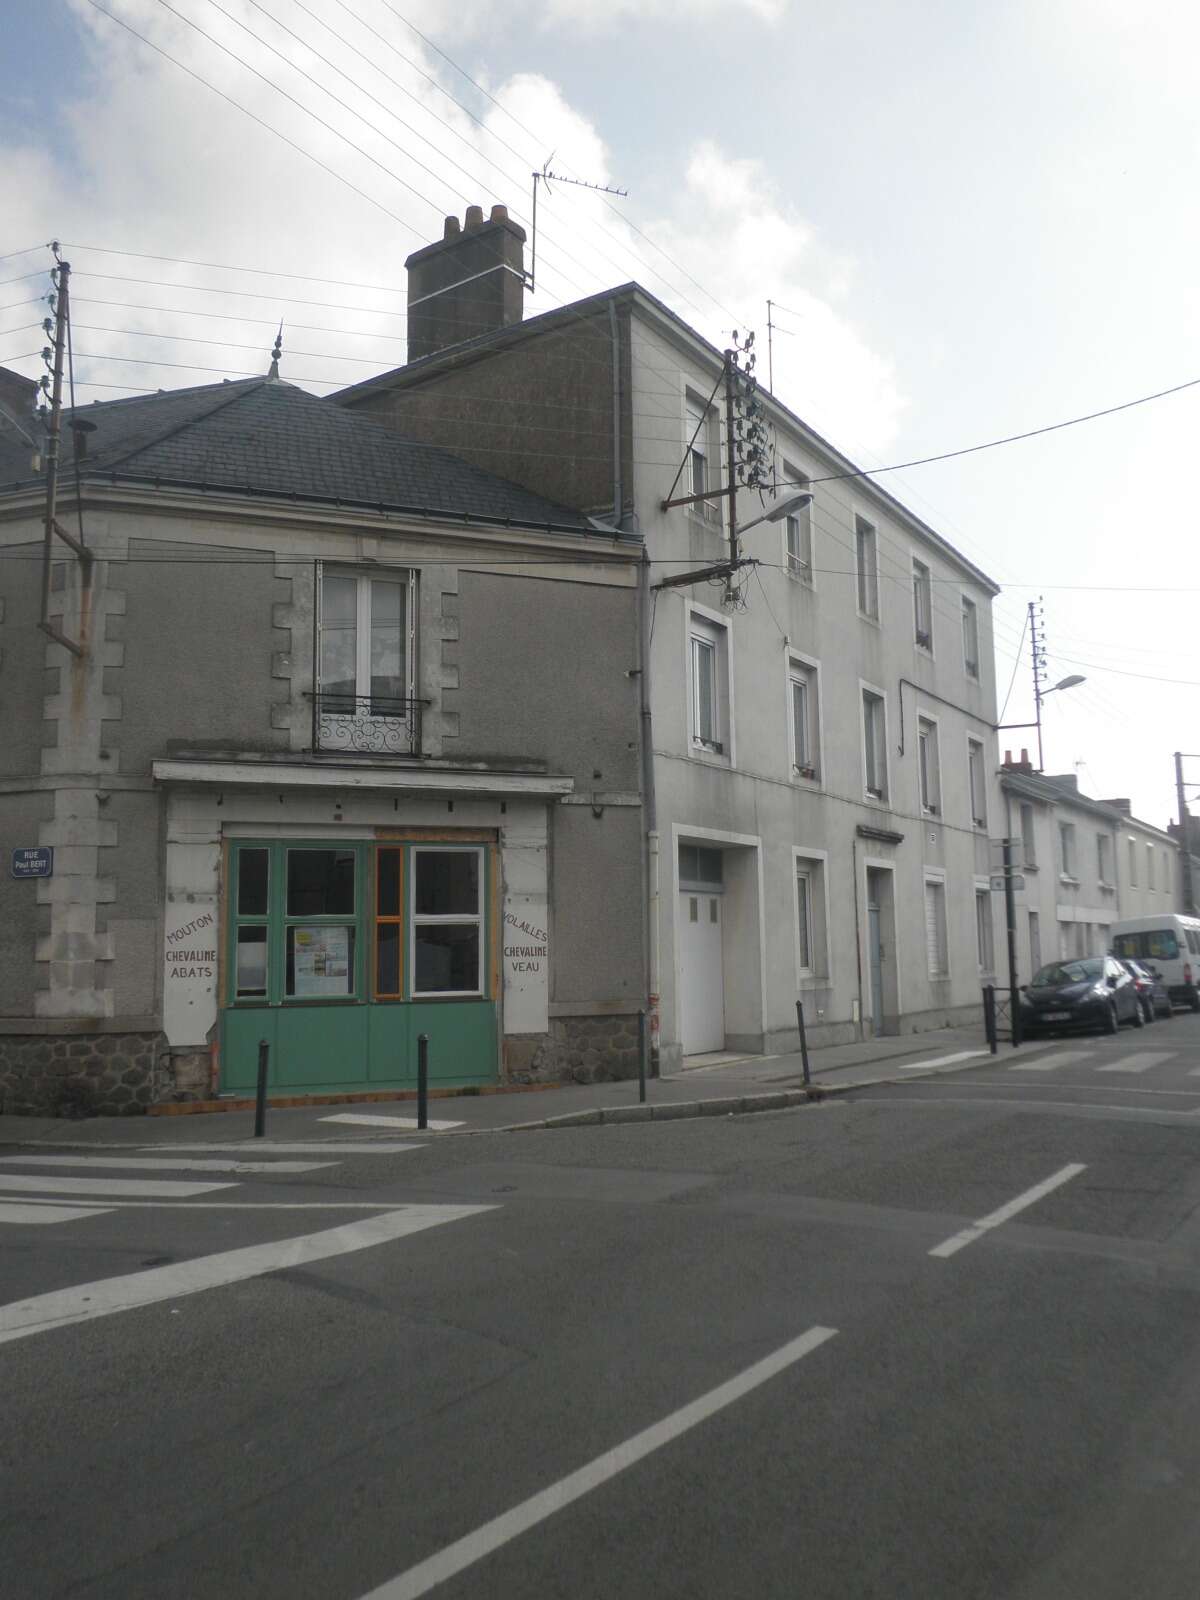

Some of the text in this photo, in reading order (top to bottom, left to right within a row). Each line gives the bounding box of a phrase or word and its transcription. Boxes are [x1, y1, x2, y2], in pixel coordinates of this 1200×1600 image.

[24, 850, 39, 859] RUE
[15, 860, 47, 869] Paul BERT
[166, 913, 213, 945] MOUTON
[503, 911, 548, 943] VOLAILLES
[166, 950, 216, 962] CHEVALINE
[504, 946, 547, 958] CHEVALINE
[512, 961, 540, 972] VEAU
[171, 967, 213, 978] ABATS
